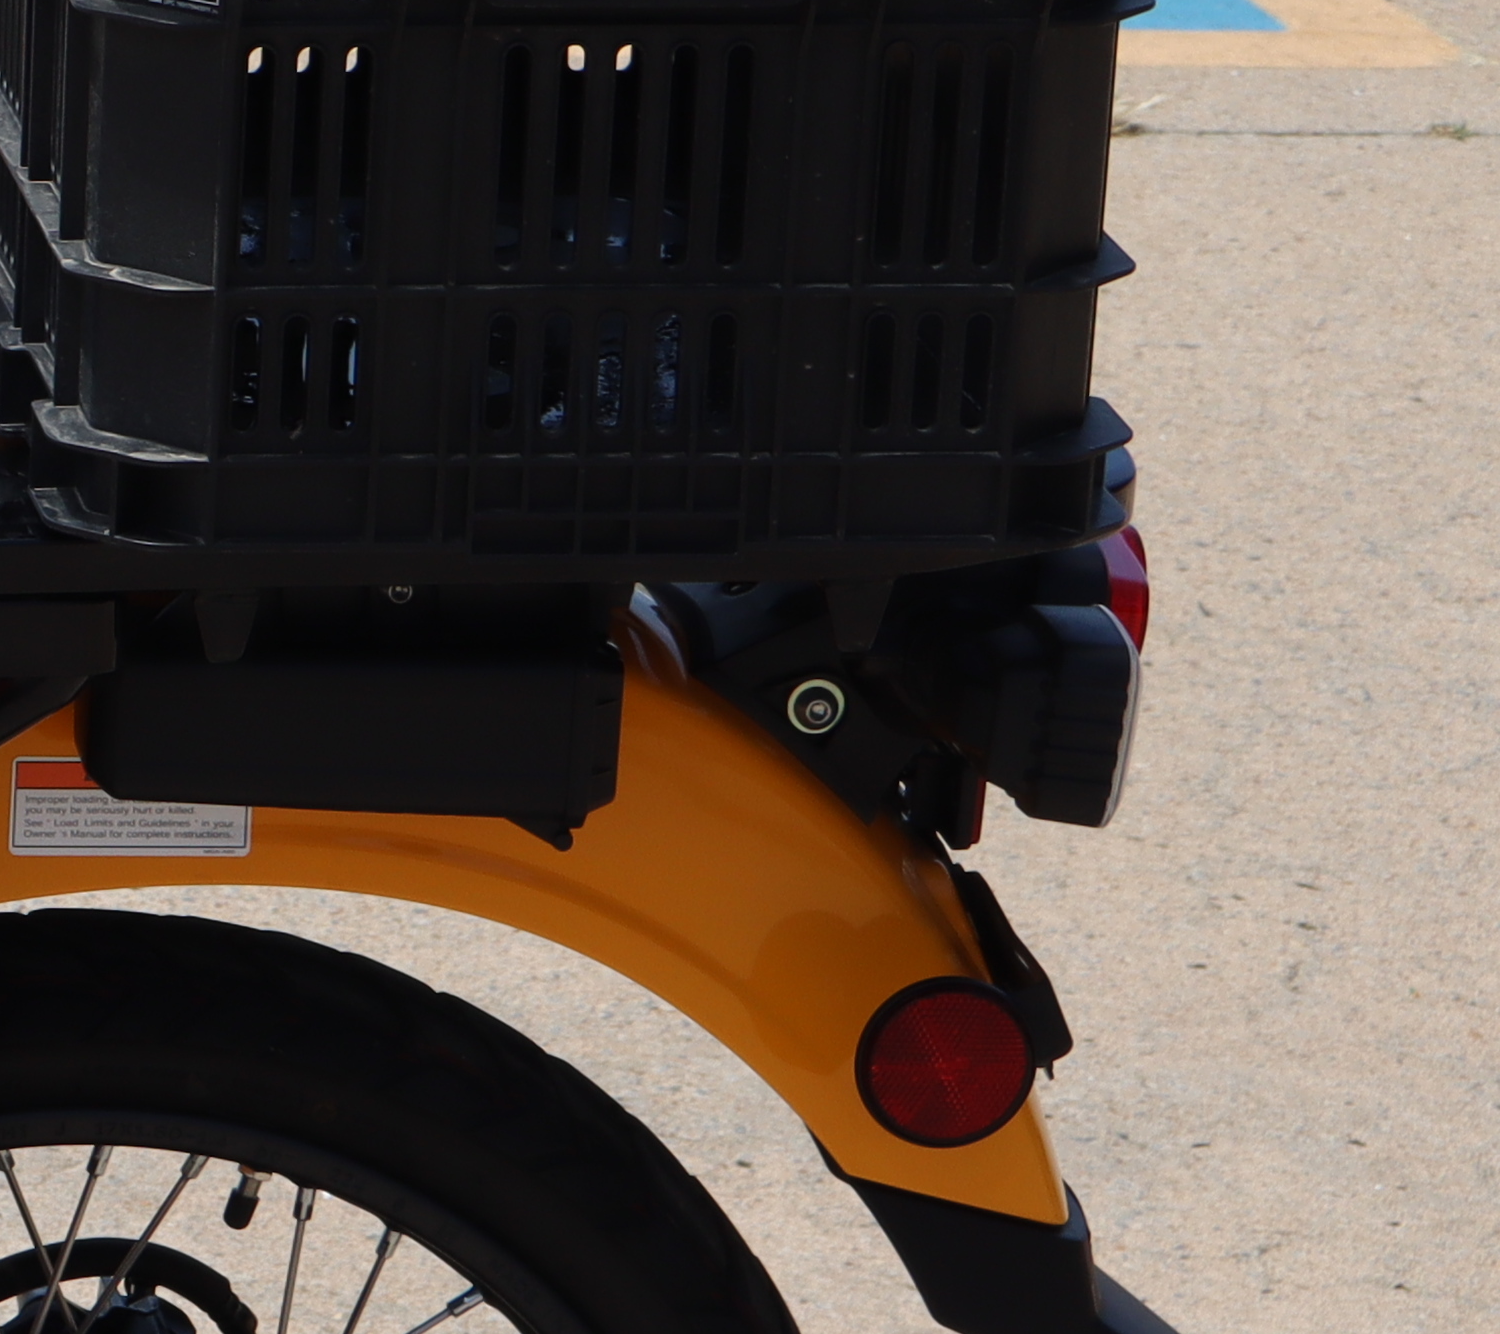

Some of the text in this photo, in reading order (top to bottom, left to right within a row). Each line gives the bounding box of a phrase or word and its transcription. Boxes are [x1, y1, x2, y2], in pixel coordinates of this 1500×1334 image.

[25, 795, 70, 805] Improper
[72, 795, 109, 805] loading
[24, 807, 43, 815] you
[46, 807, 67, 815] may
[70, 806, 82, 814] be
[86, 806, 130, 815] seriously
[132, 805, 153, 814] hurt
[23, 818, 43, 827] See
[84, 818, 114, 827] Limits
[117, 818, 136, 827] and
[138, 818, 192, 828] Guidelines
[201, 819, 210, 827] in
[212, 820, 235, 830] your
[70, 829, 107, 838] Manual
[109, 829, 123, 838] for
[126, 830, 171, 840] complete
[173, 830, 232, 839] instructions.
